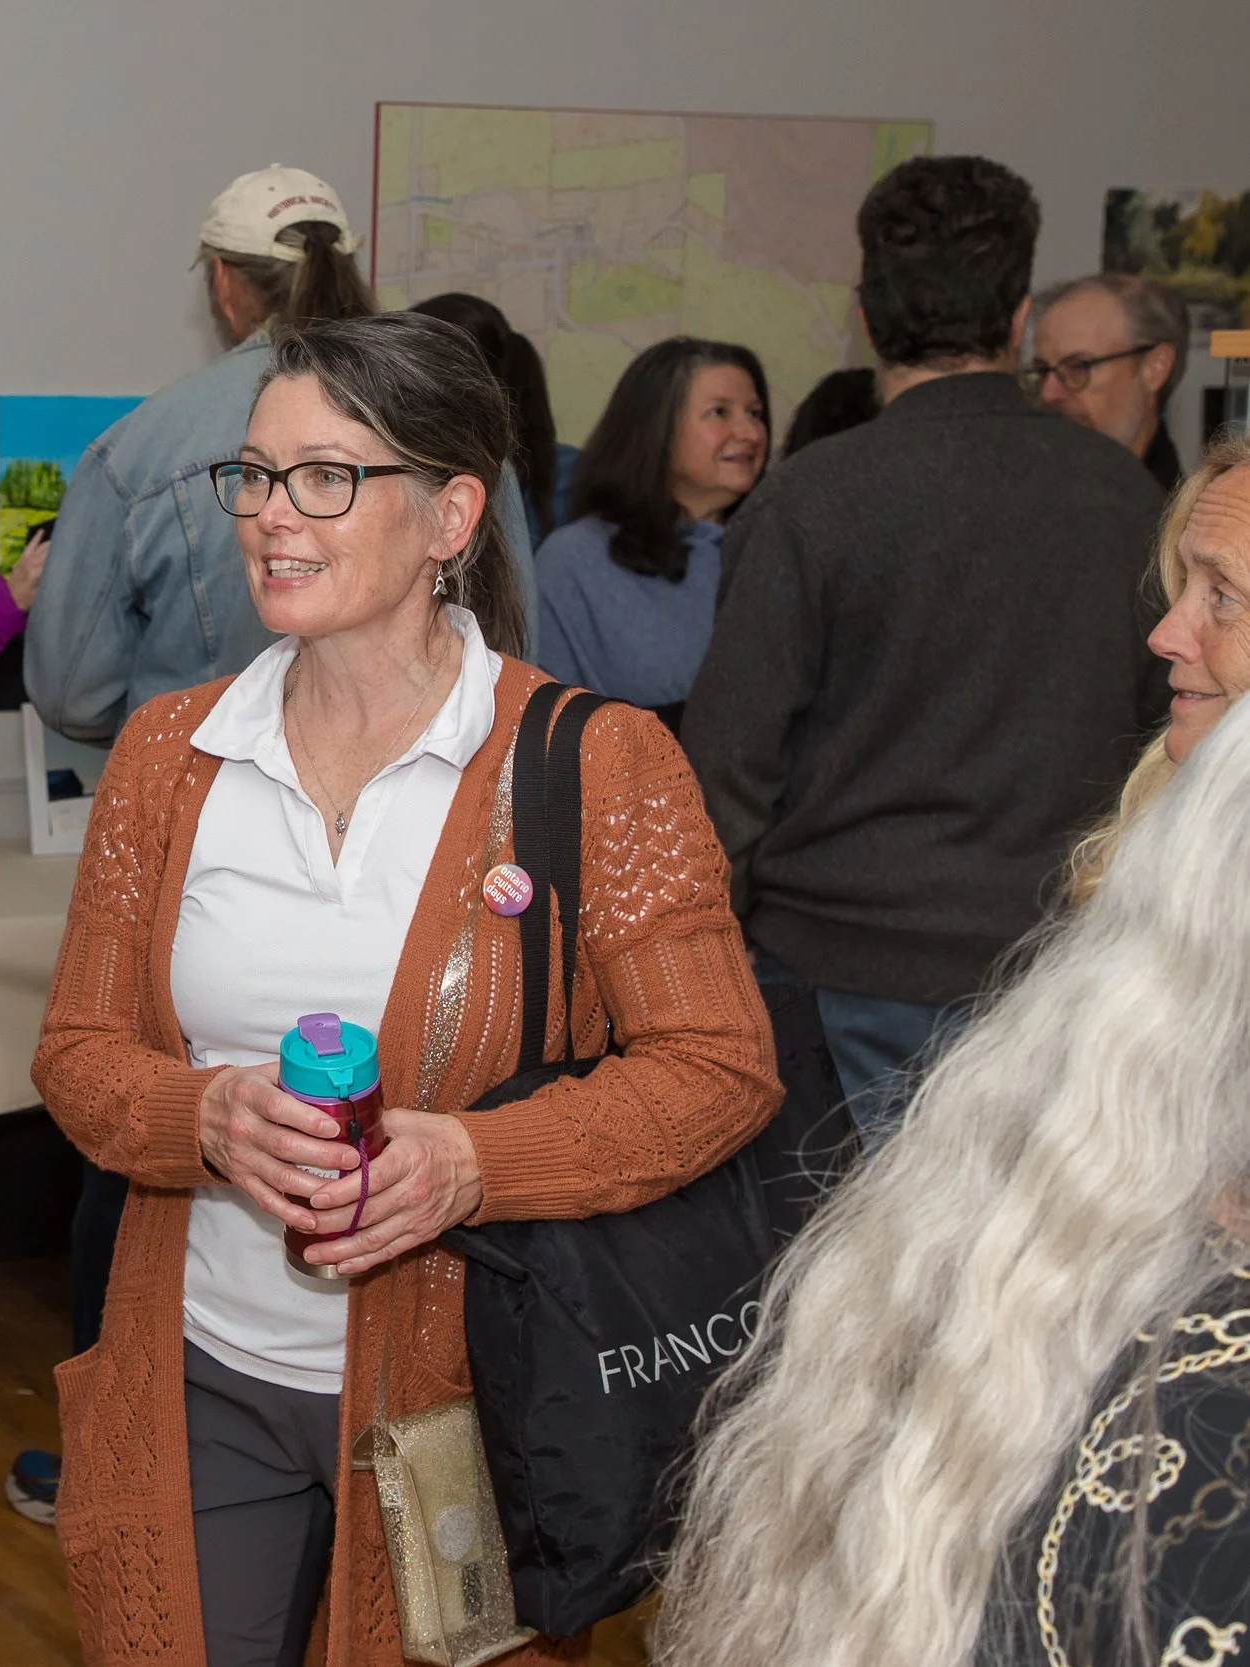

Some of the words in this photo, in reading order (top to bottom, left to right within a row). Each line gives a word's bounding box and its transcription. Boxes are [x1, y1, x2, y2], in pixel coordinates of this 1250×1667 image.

[493, 876, 523, 903] culture
[500, 866, 529, 893] ontario
[486, 884, 507, 905] days
